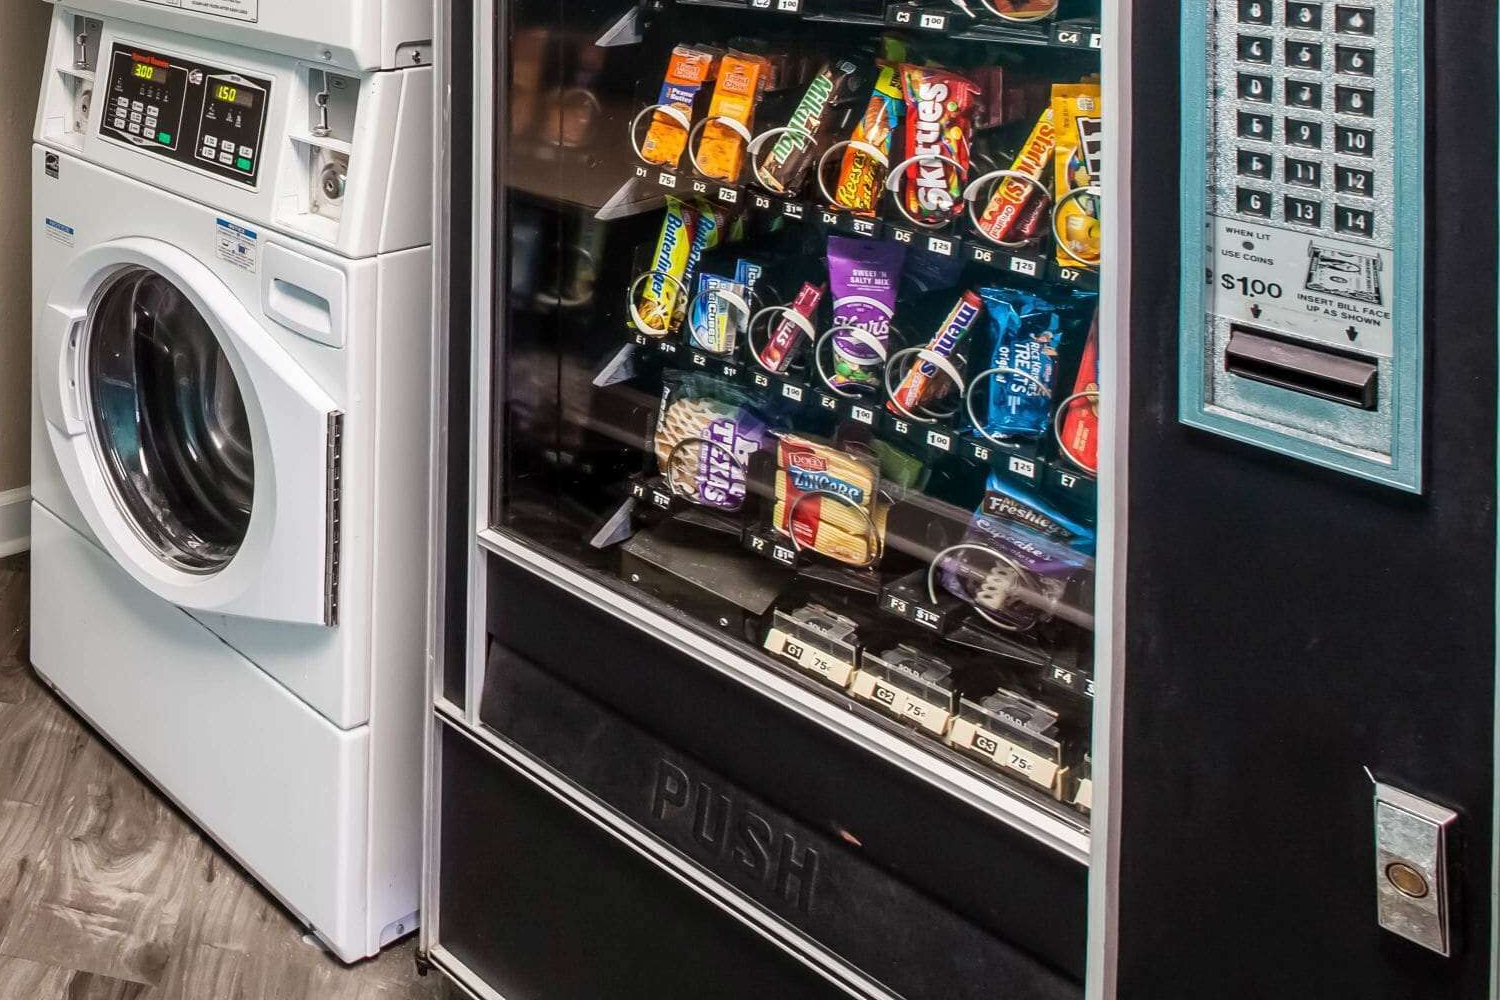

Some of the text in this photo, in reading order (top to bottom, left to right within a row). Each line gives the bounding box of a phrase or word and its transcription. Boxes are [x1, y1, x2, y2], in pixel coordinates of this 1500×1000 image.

[1251, 3, 1262, 17] B
[896, 12, 910, 23] C3
[1058, 32, 1078, 44] C4
[1251, 41, 1262, 55] C
[1352, 53, 1363, 67] 6
[1251, 80, 1262, 94] D
[1351, 94, 1363, 108] 8
[1300, 125, 1310, 140] 9
[1347, 131, 1366, 148] 10
[636, 167, 647, 178] D1
[1296, 164, 1315, 180] 11
[1347, 173, 1365, 189] 12
[693, 183, 706, 193] D2
[756, 198, 769, 208] D3
[823, 213, 838, 224] D4
[1296, 203, 1314, 220] 13
[1347, 211, 1366, 228] 14
[895, 230, 911, 243] D5
[1225, 226, 1271, 241] WHEN LIT
[974, 249, 992, 262] D6
[1221, 249, 1275, 266] USE COINS
[850, 276, 890, 286] SALTY MIX
[1060, 268, 1080, 282] D7
[1297, 293, 1391, 320] INSERT BILL FACE
[1306, 304, 1381, 327] UP AS SHOWN
[635, 335, 647, 345] E1
[693, 355, 707, 366] E2
[755, 375, 768, 386] E3
[822, 397, 836, 408] E4
[895, 422, 909, 434] E5
[974, 447, 989, 460] E6
[1061, 476, 1077, 488] E7
[633, 485, 643, 497] F1
[752, 538, 764, 550] F2
[890, 598, 906, 613] F3
[787, 643, 803, 659] G1
[1053, 667, 1073, 685] F4
[876, 687, 894, 702] G2
[976, 735, 997, 752] G3
[650, 758, 819, 913] PUSH
